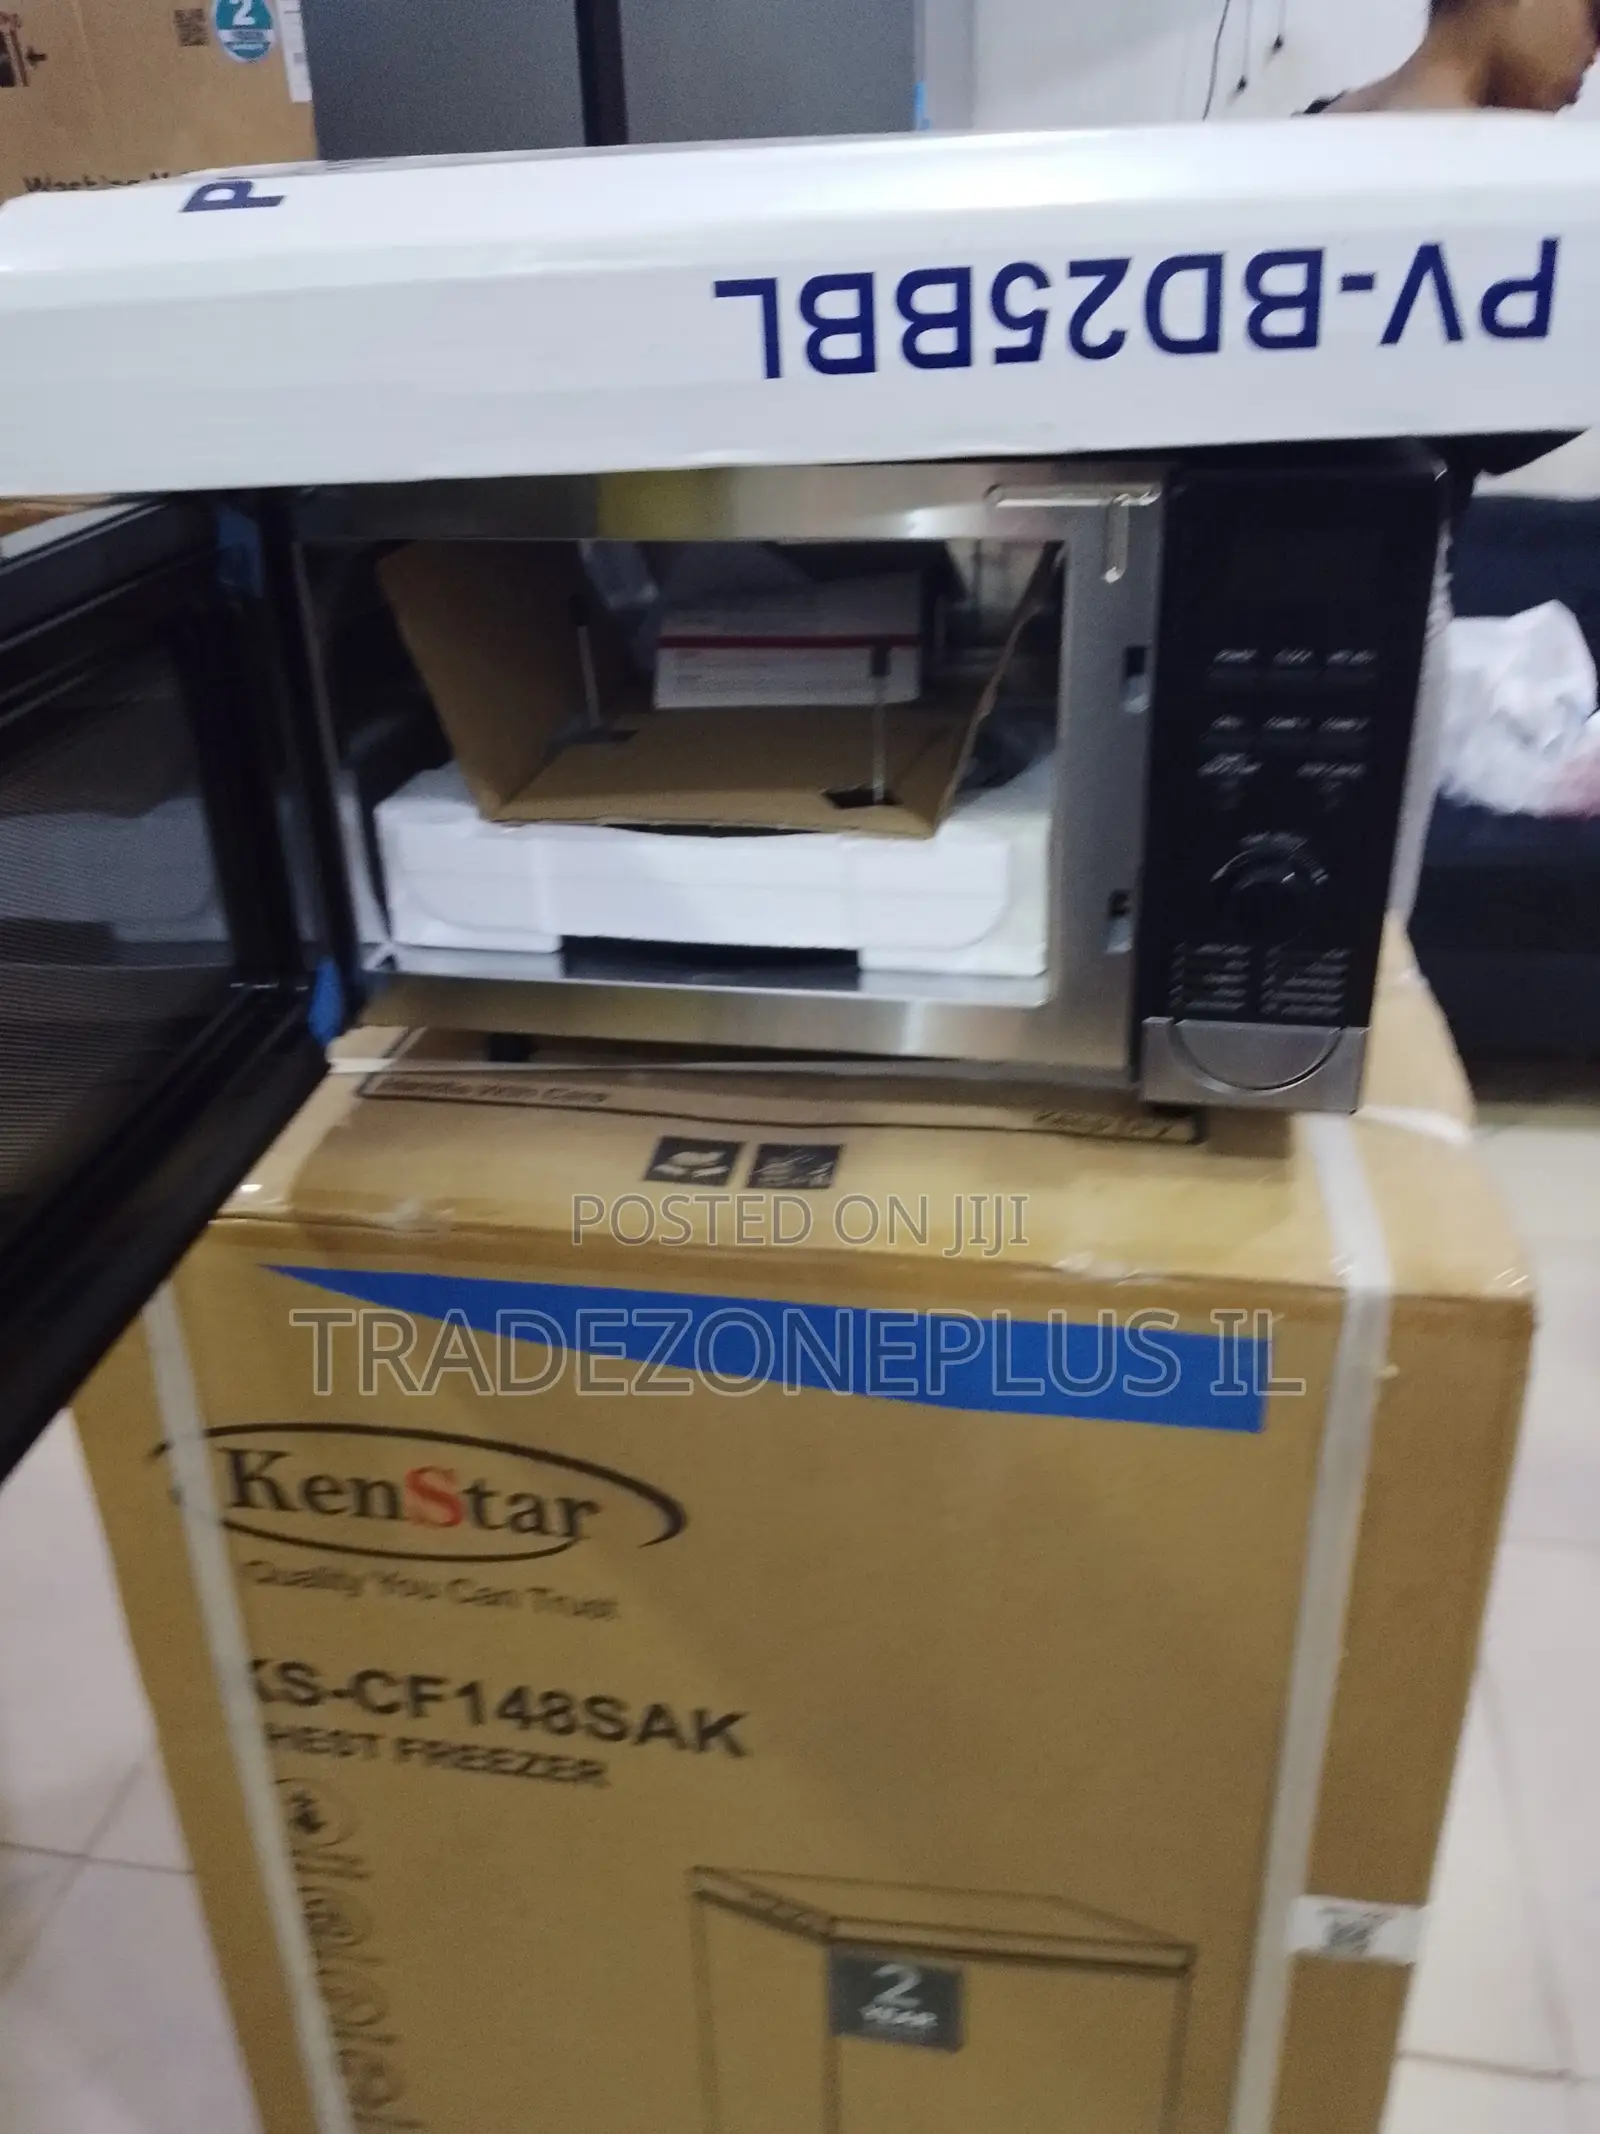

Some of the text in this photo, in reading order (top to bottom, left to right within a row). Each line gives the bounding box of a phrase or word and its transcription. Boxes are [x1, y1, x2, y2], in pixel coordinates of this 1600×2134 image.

[713, 236, 1561, 380] PV-BD25BBL
[216, 1446, 600, 1540] KenStar
[265, 1722, 609, 1786] HEST FREEZER
[870, 1962, 923, 2008] 2
